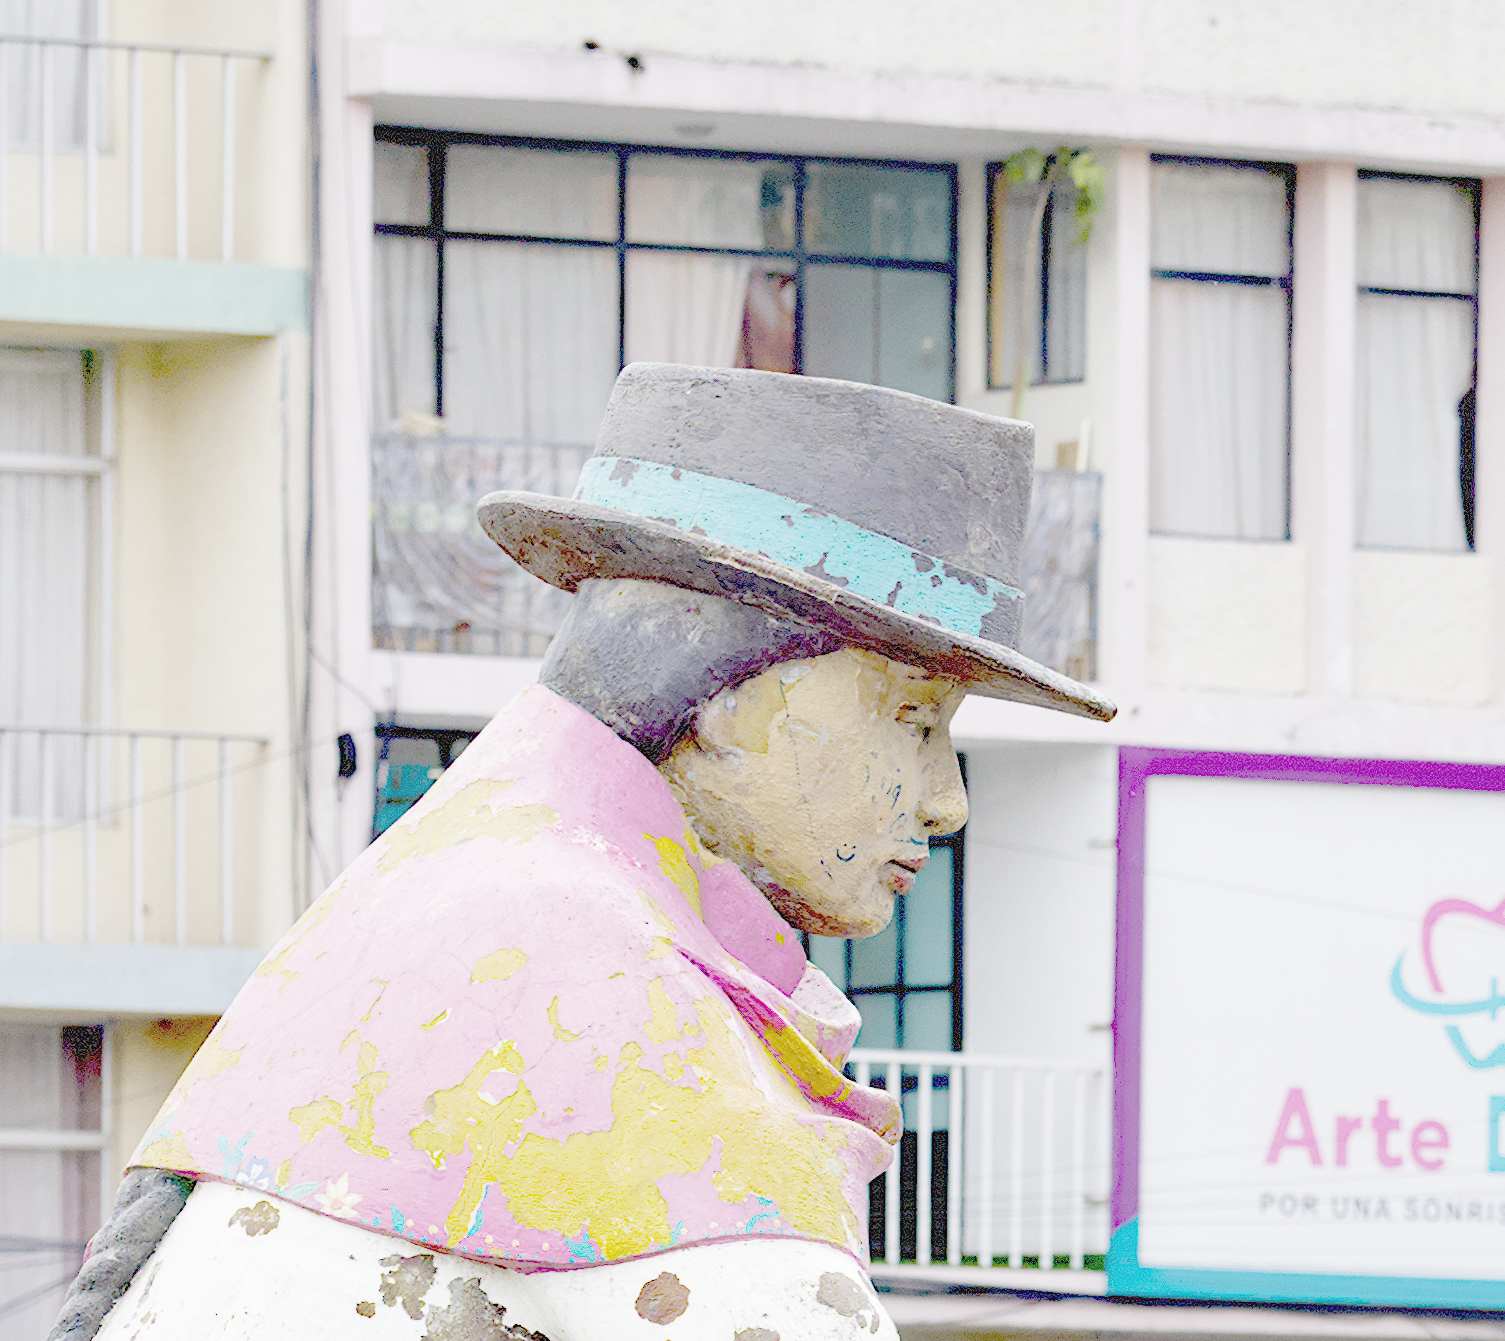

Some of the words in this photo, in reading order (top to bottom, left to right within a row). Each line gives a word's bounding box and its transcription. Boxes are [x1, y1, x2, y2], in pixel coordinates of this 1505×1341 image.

[1265, 1087, 1451, 1171] Arte
[1259, 1192, 1317, 1220] POR
[1331, 1195, 1391, 1222] UNA
